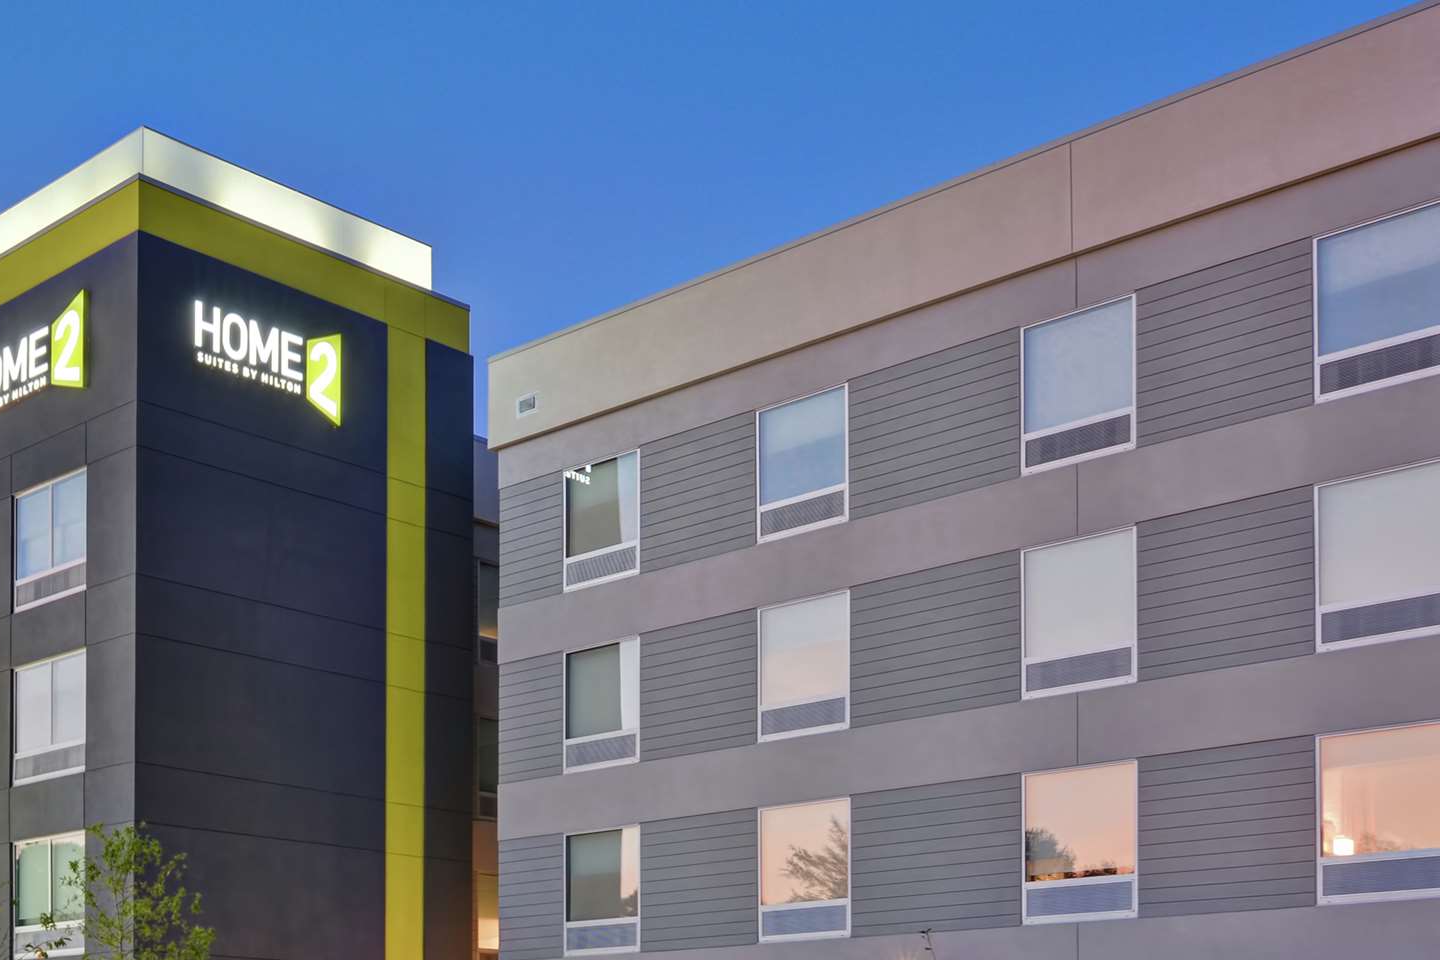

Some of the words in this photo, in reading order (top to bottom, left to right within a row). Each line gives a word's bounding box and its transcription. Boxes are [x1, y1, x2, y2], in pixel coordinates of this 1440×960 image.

[54, 309, 81, 382] 2
[194, 299, 304, 381] HOME
[309, 341, 338, 417] 2
[197, 351, 239, 374] SUITES
[242, 366, 258, 380] BY
[261, 372, 302, 395] HILTON
[11, 375, 47, 400] HILTON
